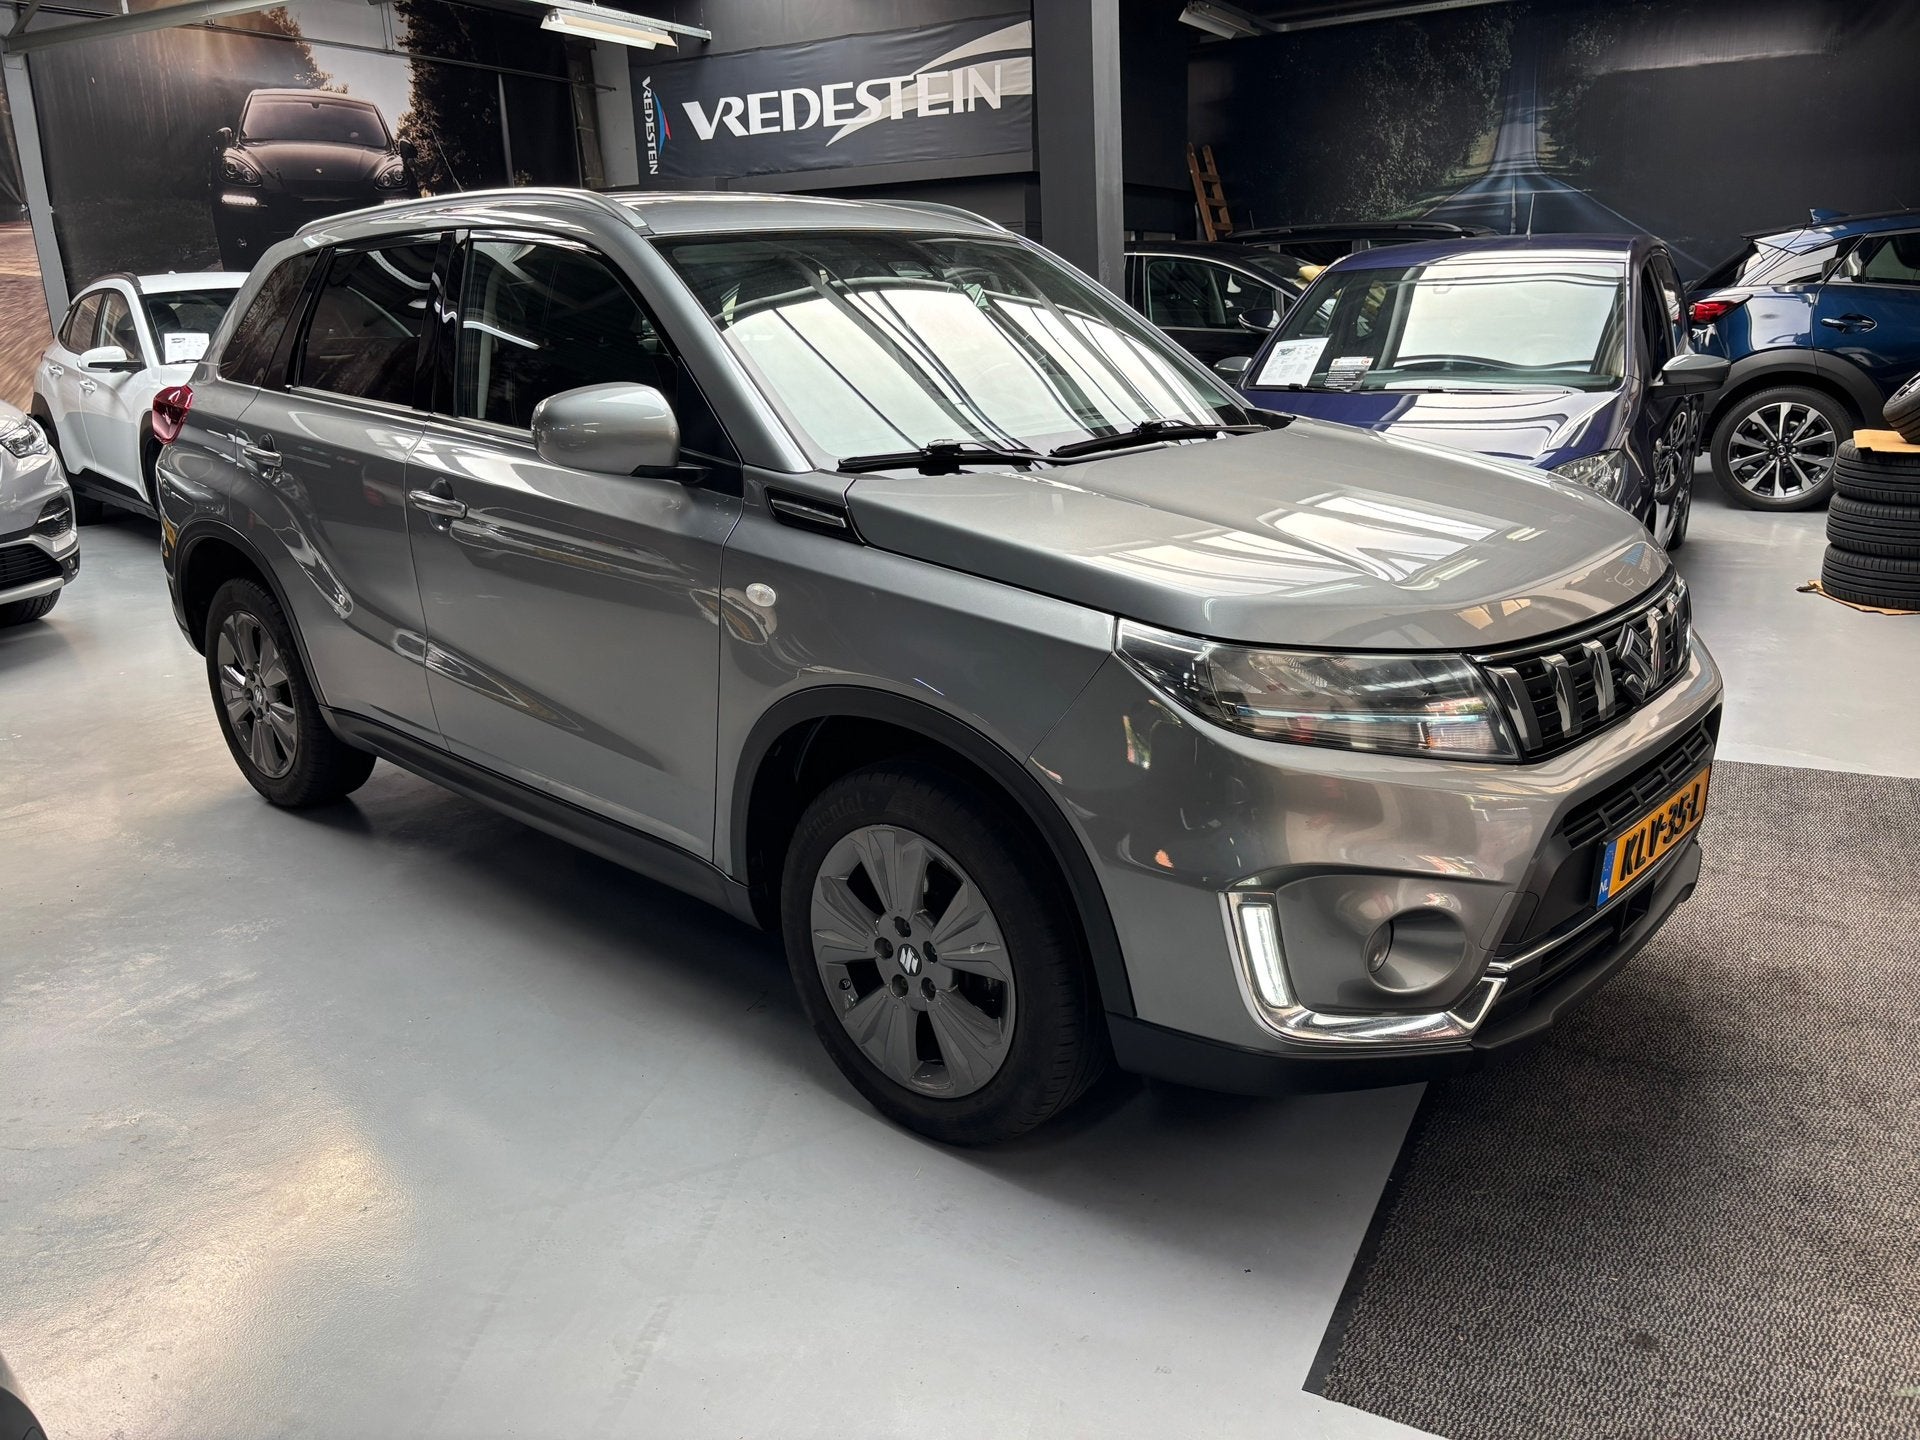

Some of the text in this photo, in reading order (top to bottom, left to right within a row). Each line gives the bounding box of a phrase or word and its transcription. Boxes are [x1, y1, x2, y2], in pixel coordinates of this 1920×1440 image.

[642, 76, 659, 175] VREDESTEIN
[682, 64, 1001, 143] VREDESTEIN
[1600, 878, 1609, 893] NL
